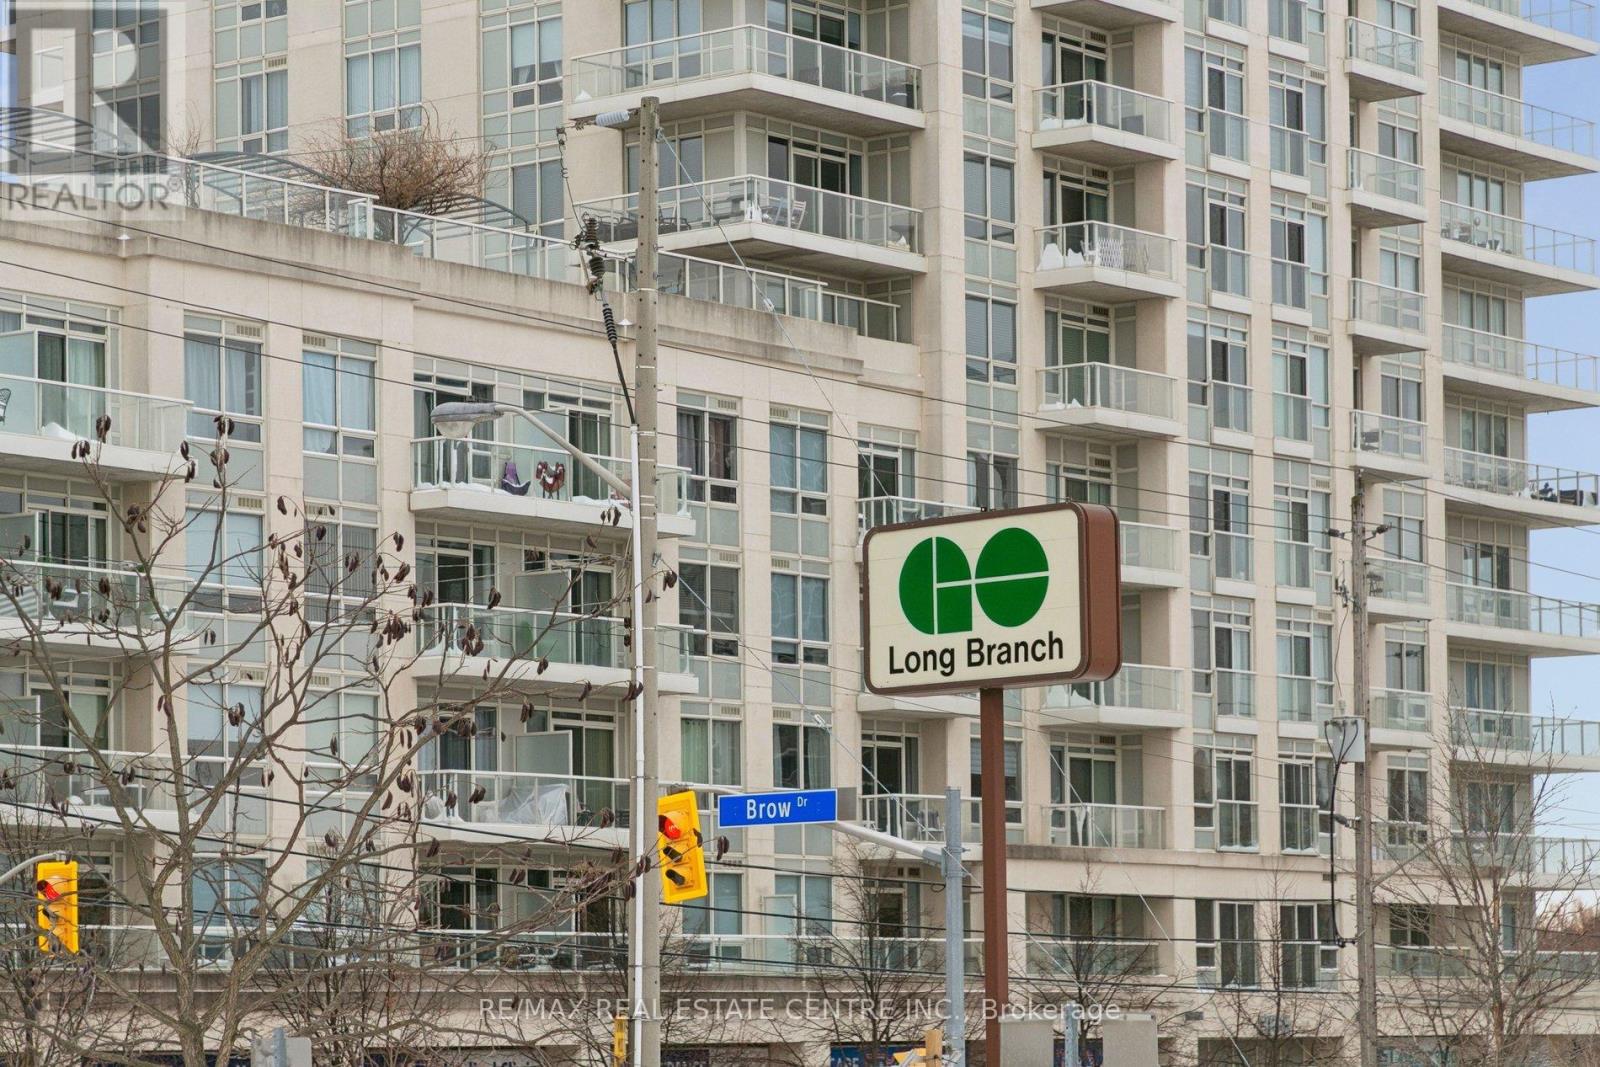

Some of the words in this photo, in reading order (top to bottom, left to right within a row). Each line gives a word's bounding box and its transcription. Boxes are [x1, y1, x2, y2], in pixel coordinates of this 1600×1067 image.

[888, 646, 955, 677] Long
[966, 631, 1064, 668] Branch
[746, 798, 791, 820] Brow
[797, 796, 808, 808] Dr
